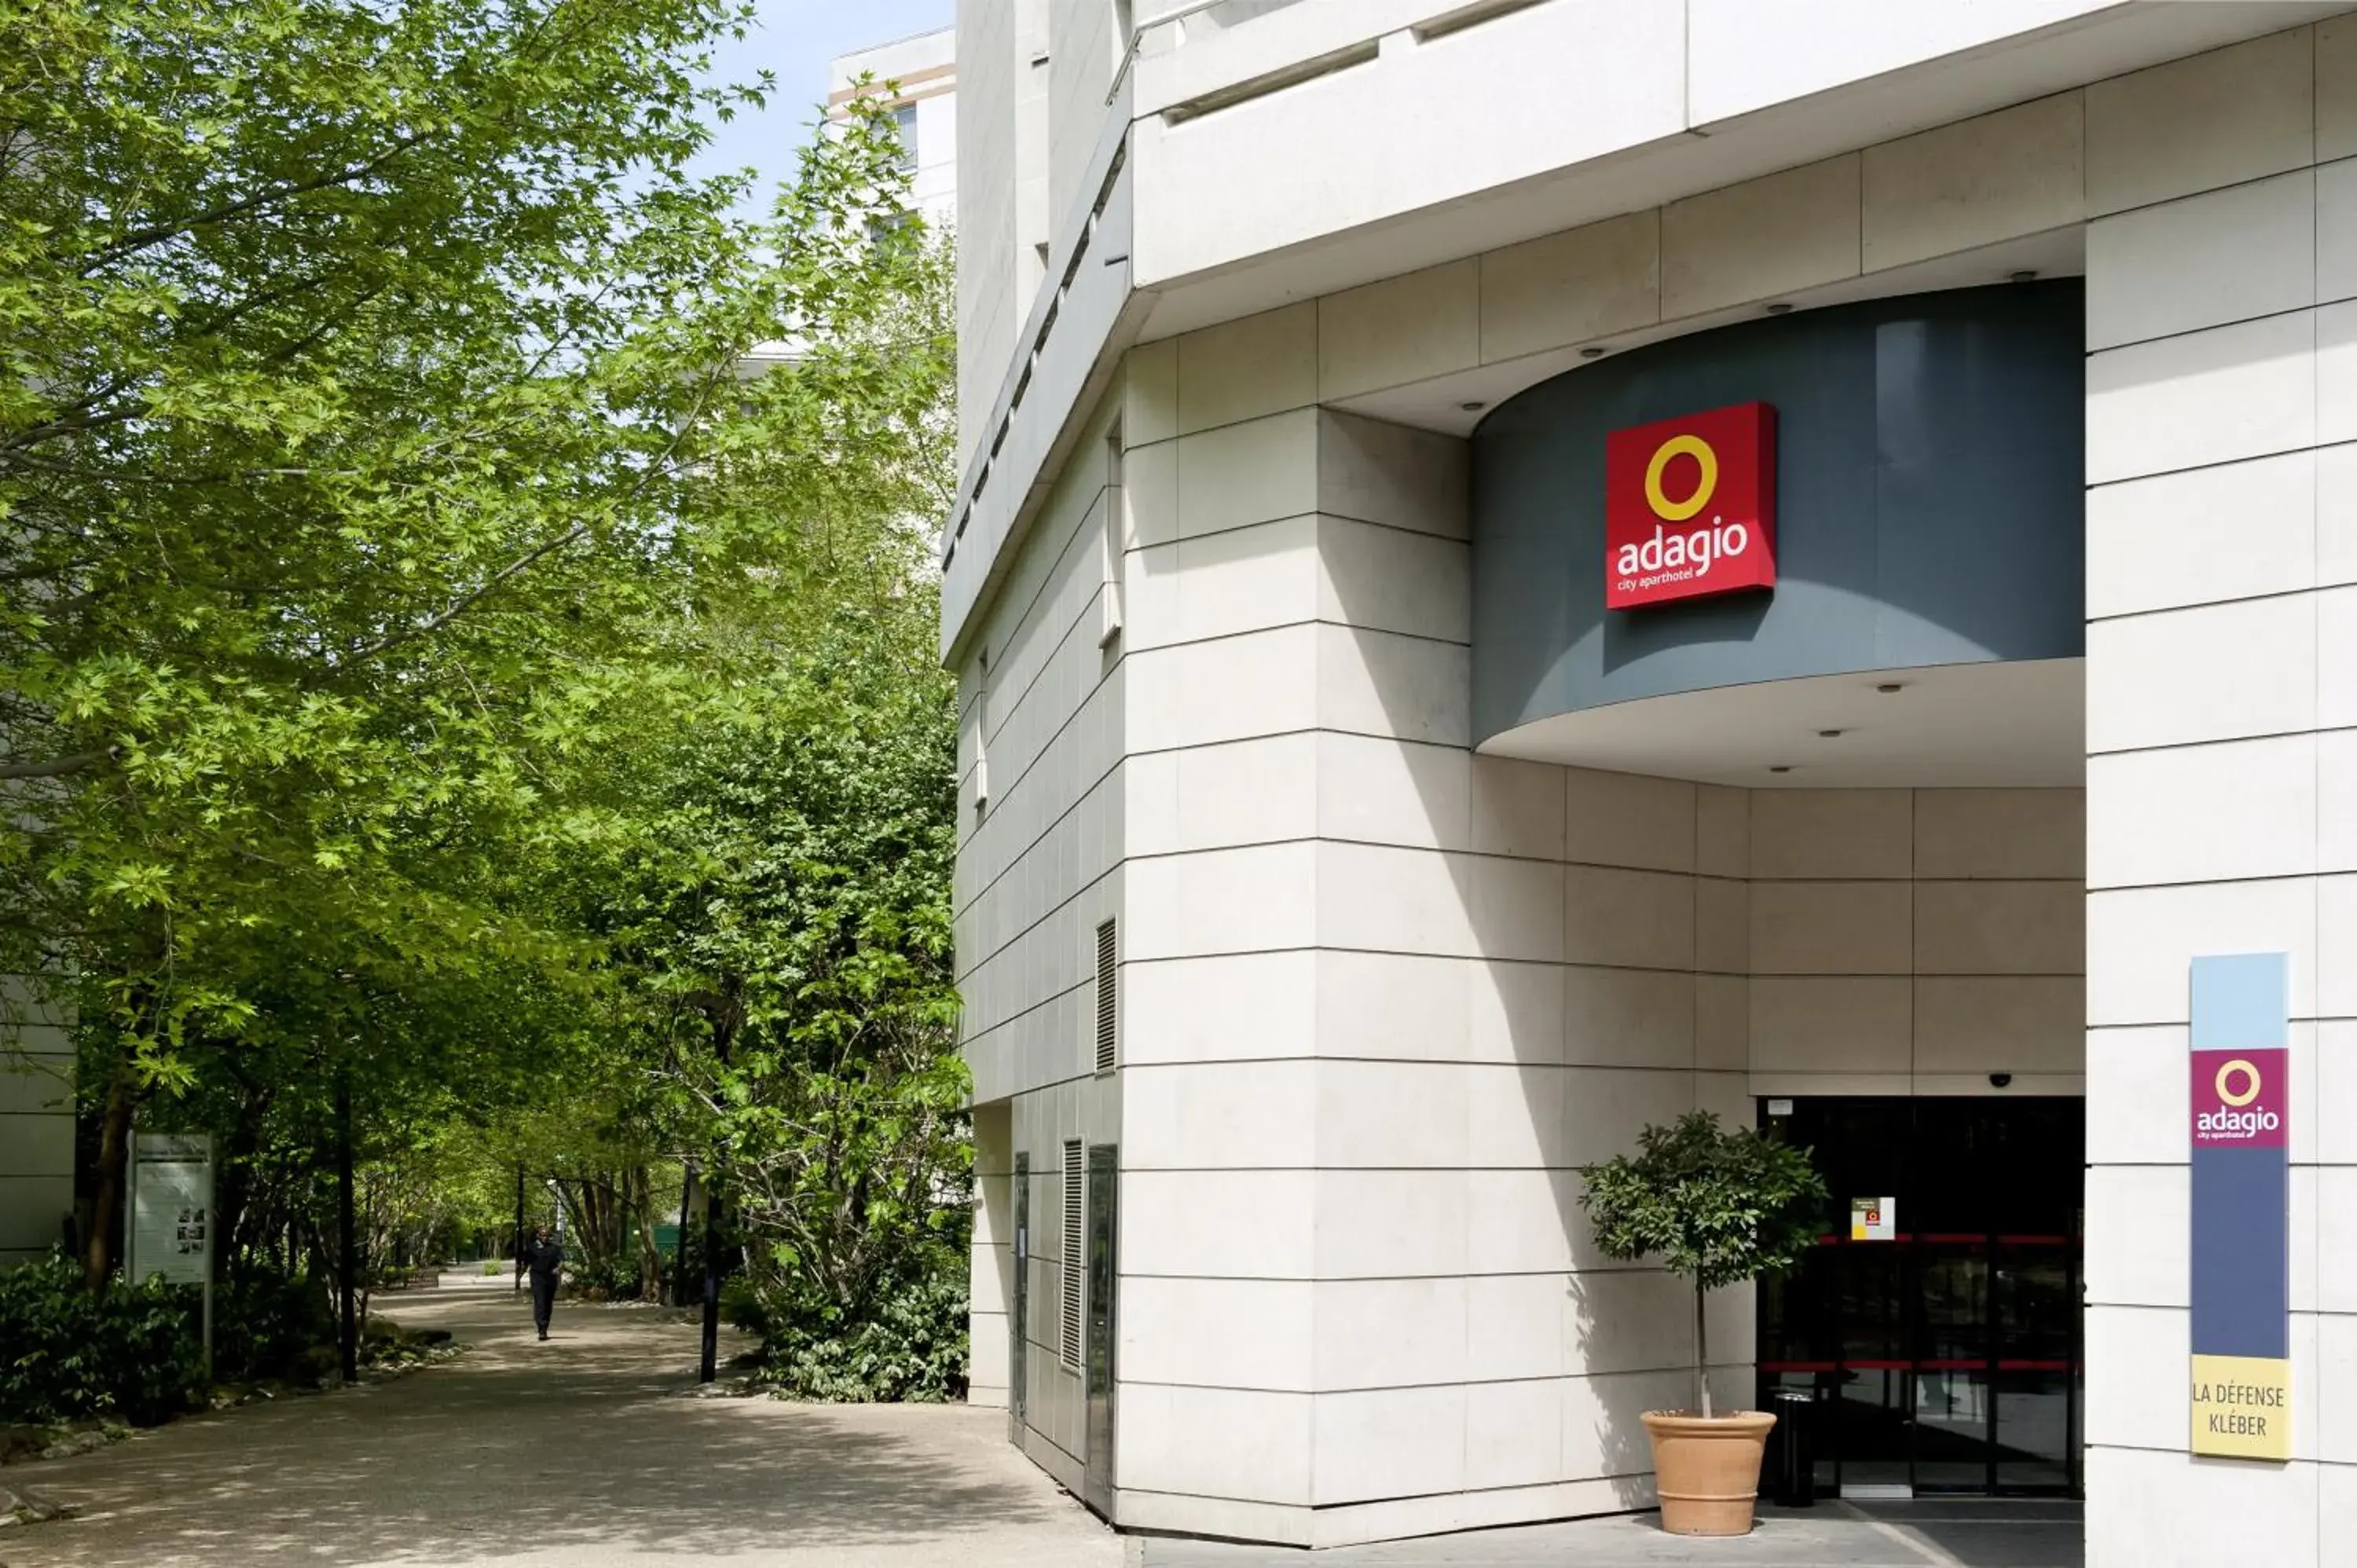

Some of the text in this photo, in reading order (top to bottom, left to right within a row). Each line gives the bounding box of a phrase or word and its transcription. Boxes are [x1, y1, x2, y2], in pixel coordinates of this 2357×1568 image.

[1618, 515, 1747, 577] adagio
[1617, 566, 1693, 592] city aparthotel
[2198, 1105, 2278, 1138] adagio
[2193, 1379, 2284, 1407] LA DÉFENSE
[2209, 1409, 2267, 1436] KLÉBER
